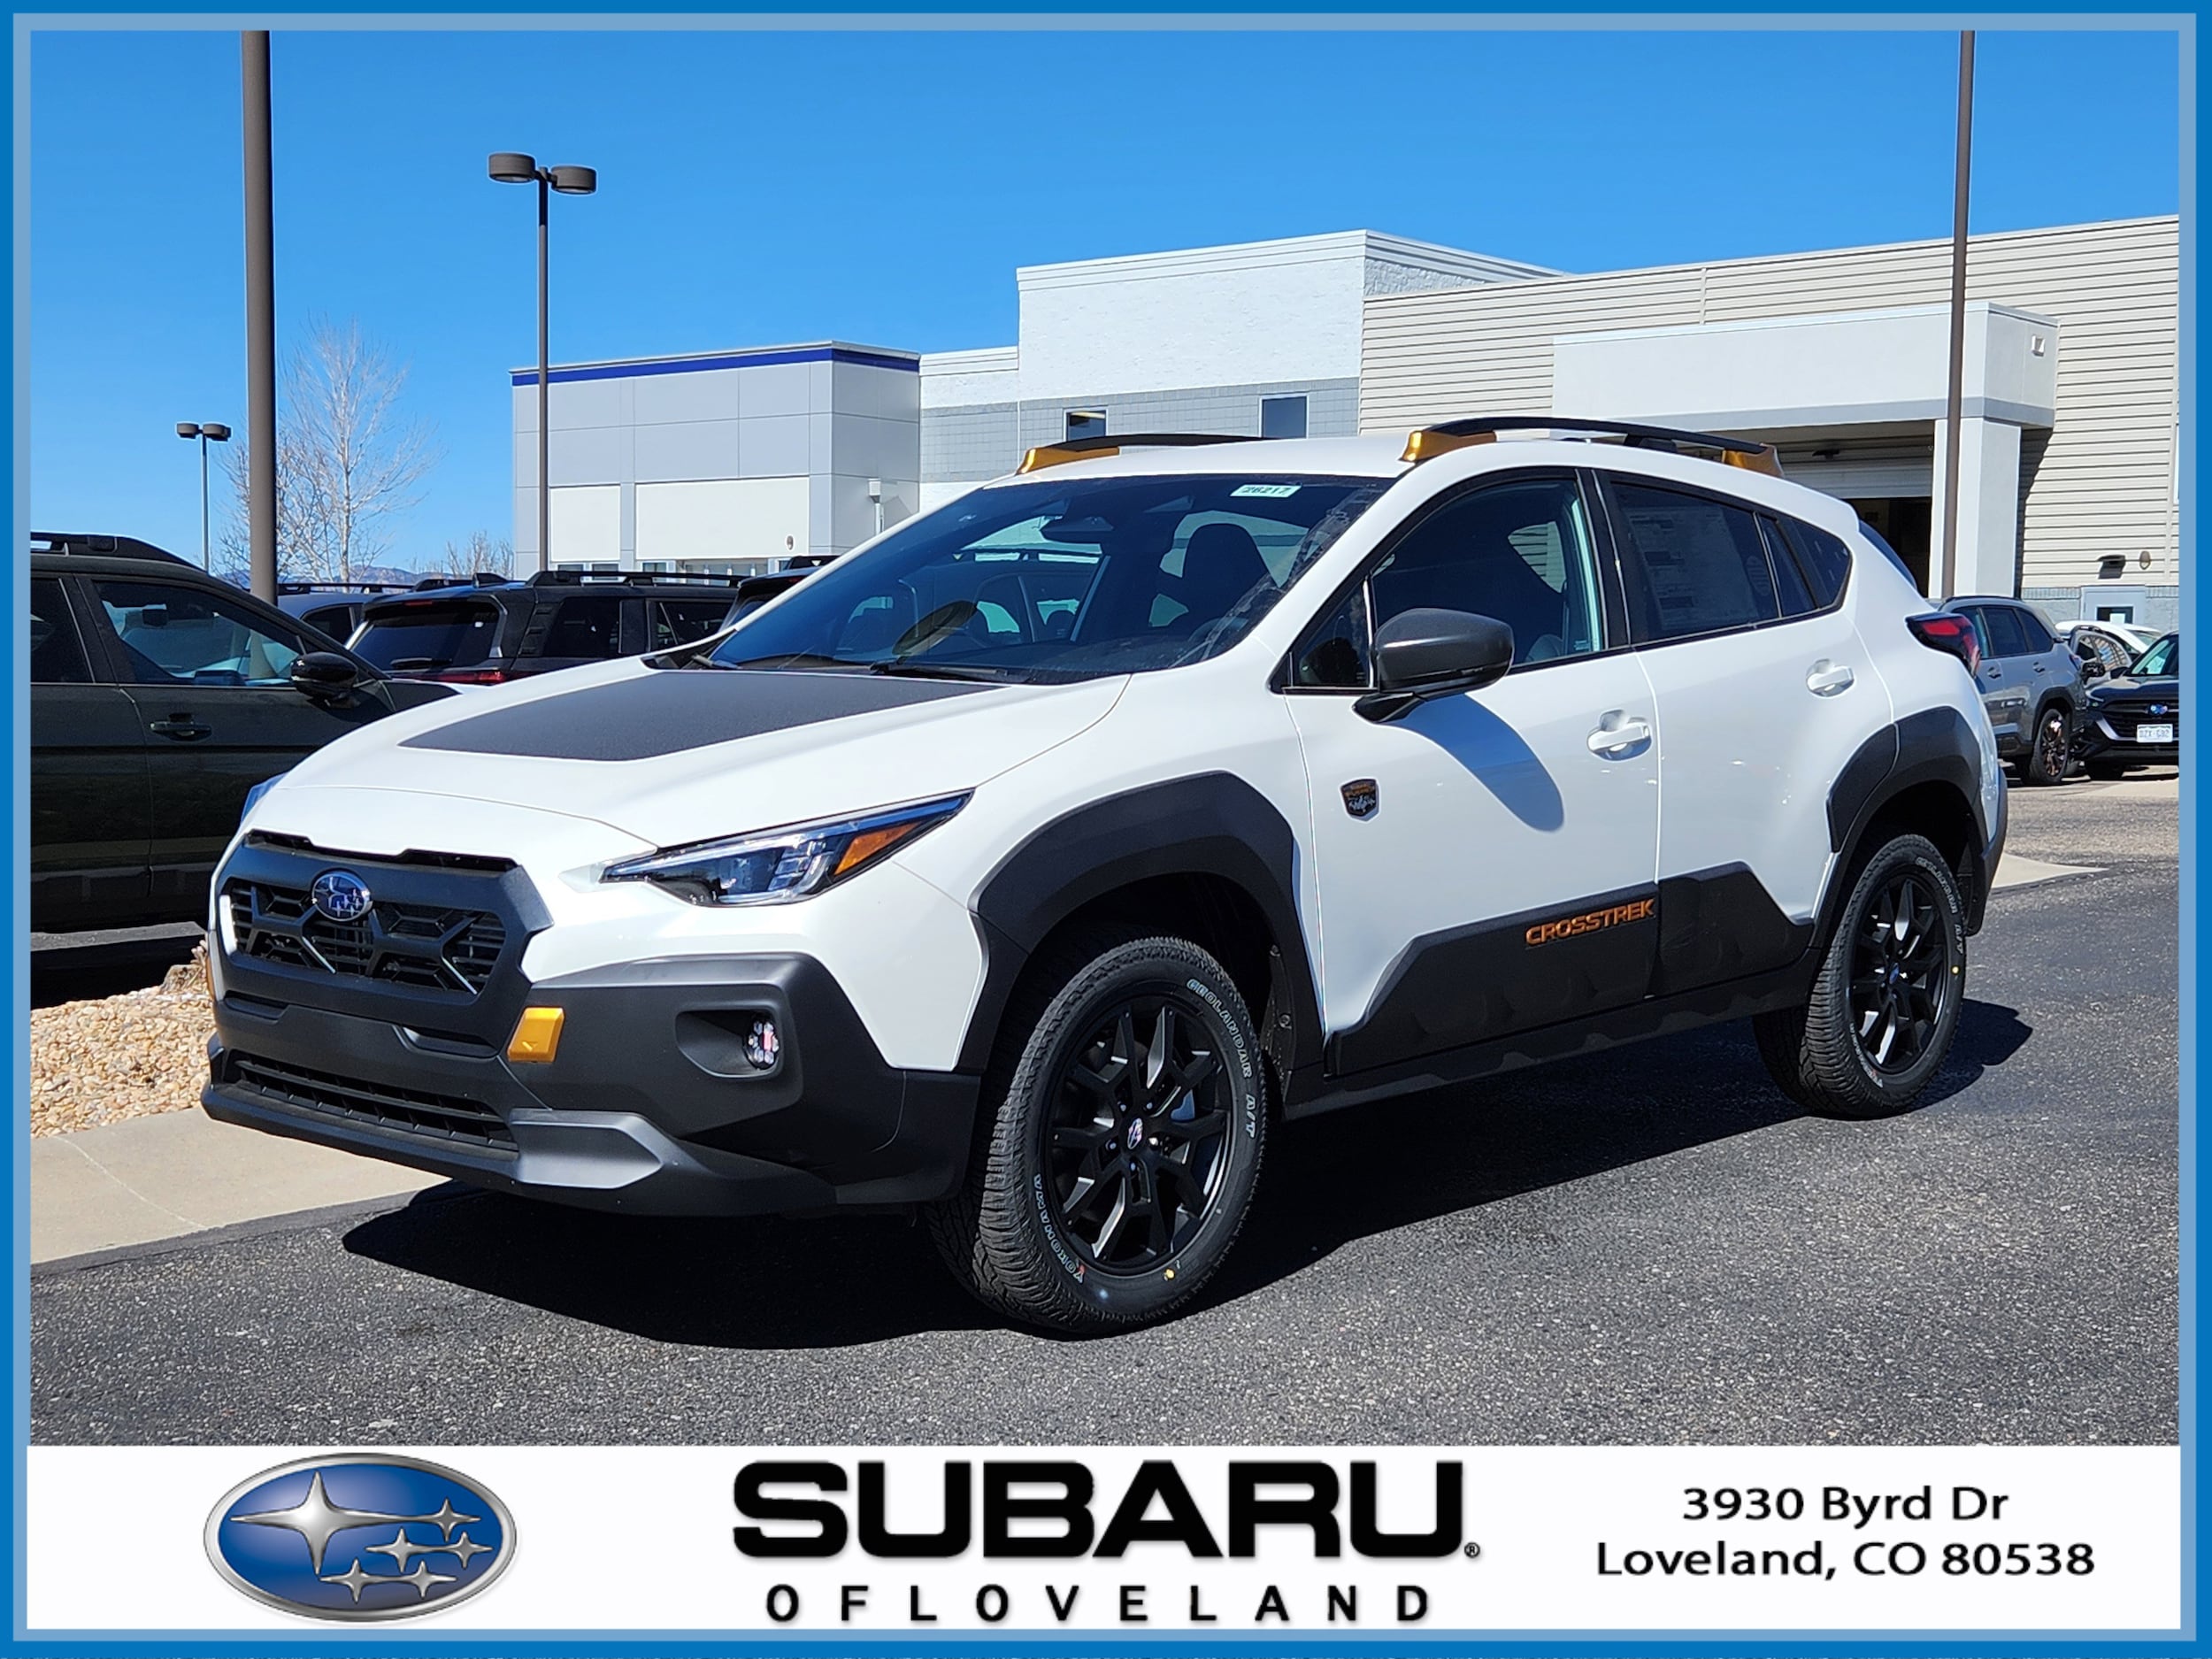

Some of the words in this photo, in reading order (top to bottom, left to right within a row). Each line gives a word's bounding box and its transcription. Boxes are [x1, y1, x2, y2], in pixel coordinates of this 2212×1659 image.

[1525, 898, 1655, 946] CROSSTREK
[1186, 978, 1253, 1079] GEOLANDAR
[1033, 1173, 1084, 1283] YOKOHAMA
